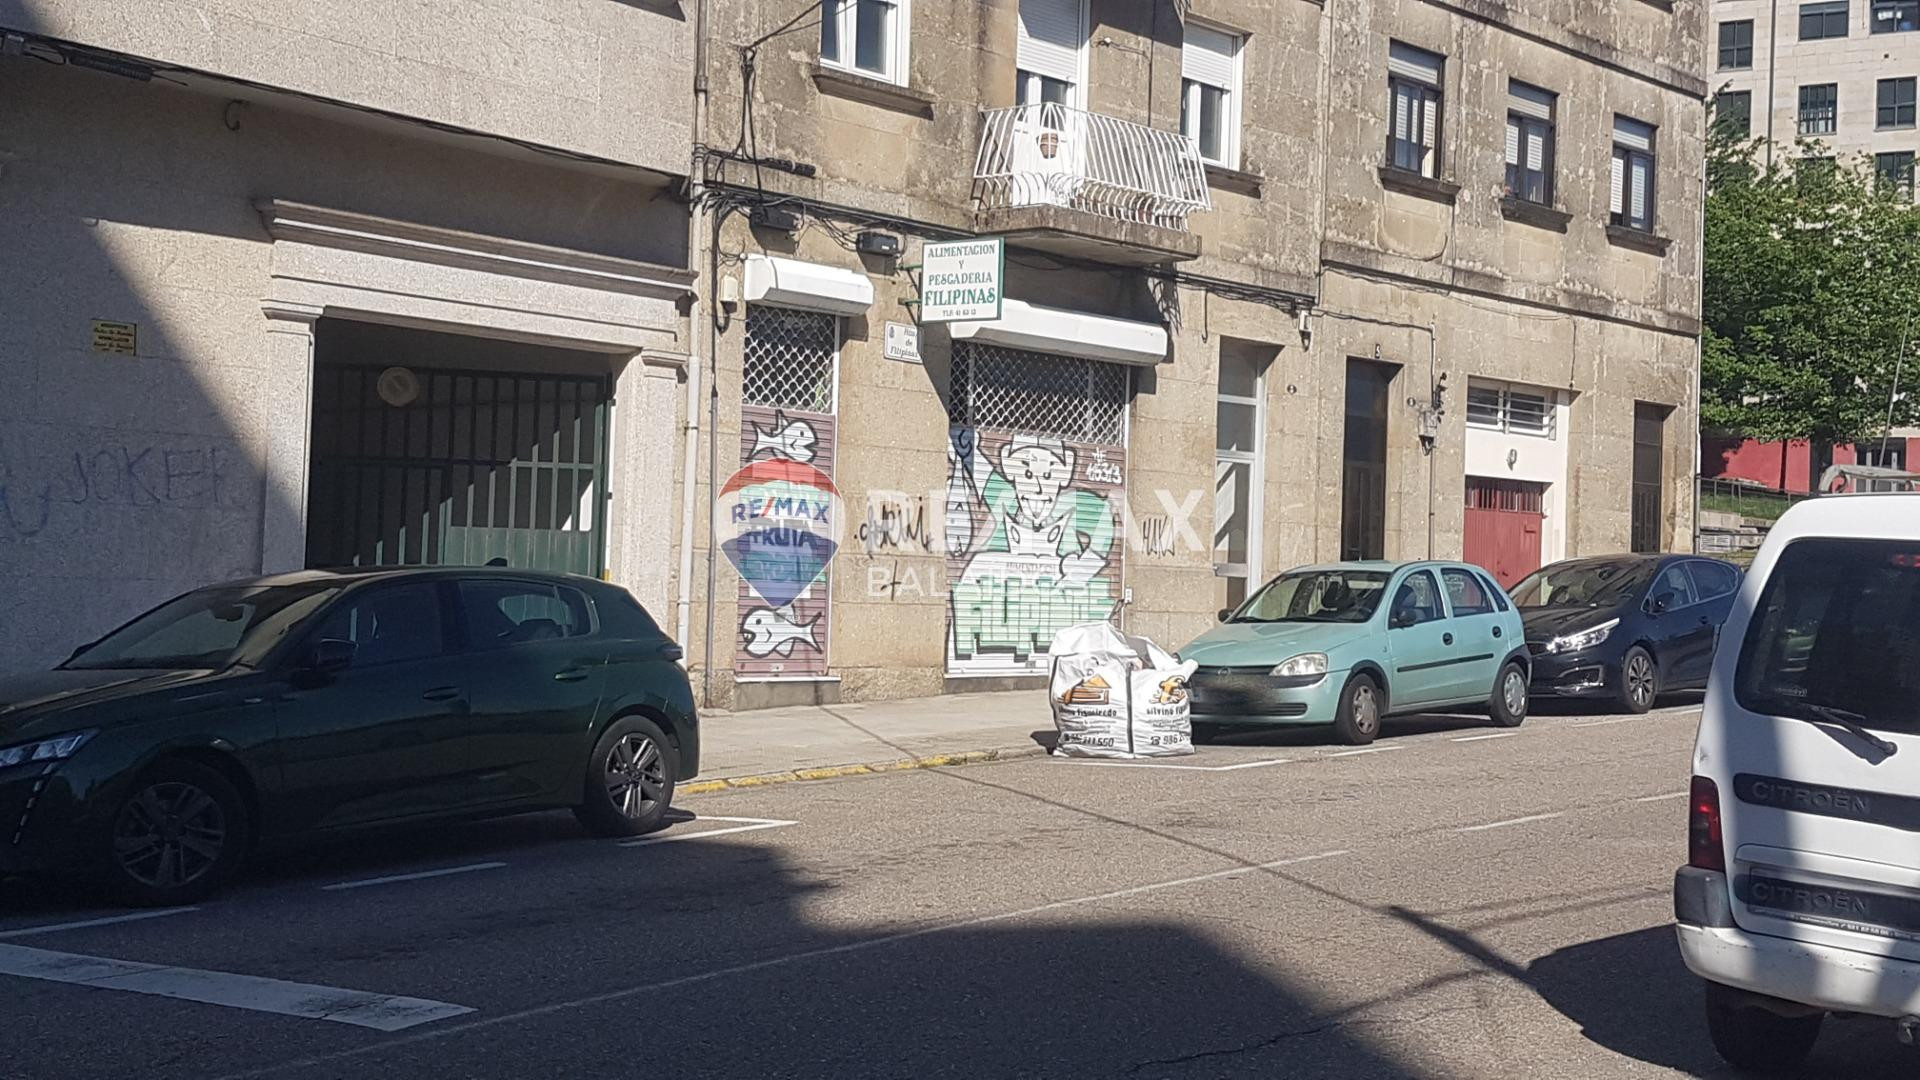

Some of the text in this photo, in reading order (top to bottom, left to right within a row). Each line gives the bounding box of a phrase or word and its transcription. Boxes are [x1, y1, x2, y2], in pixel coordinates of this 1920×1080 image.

[928, 244, 995, 258] ALIMENTACION
[958, 260, 965, 270] Y
[928, 272, 993, 285] PESCADERIA
[924, 287, 996, 306] FILIPINAS
[1752, 782, 1868, 812] CITROËN
[1752, 882, 1868, 914] CITROËN
